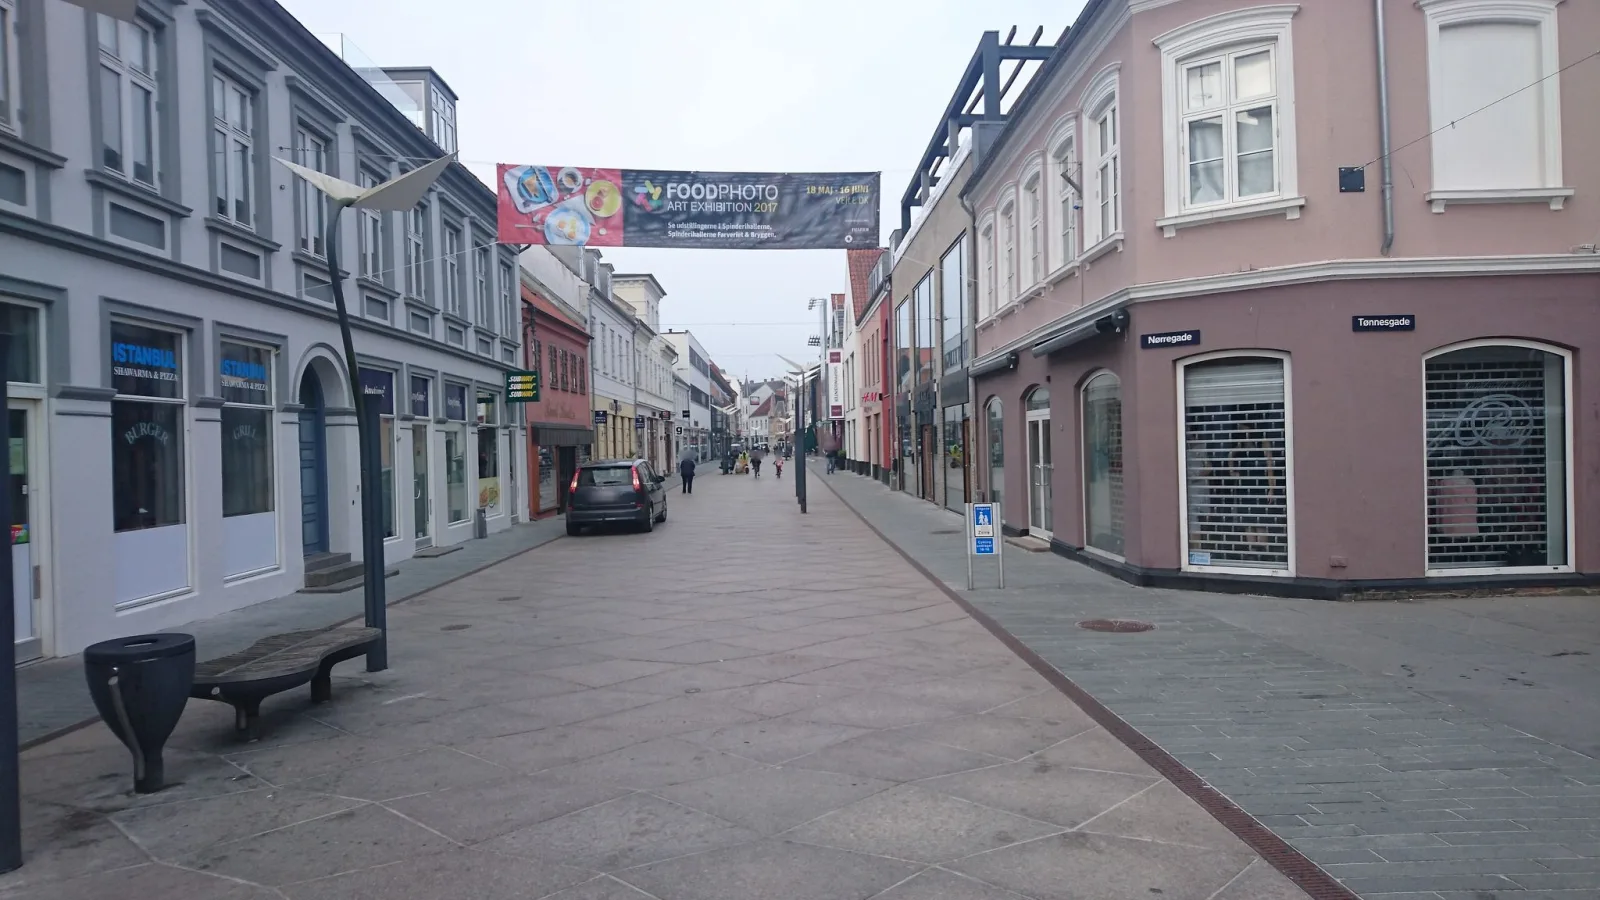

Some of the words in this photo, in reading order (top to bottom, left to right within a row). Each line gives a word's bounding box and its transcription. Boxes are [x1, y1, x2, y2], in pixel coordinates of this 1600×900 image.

[667, 182, 779, 201] FOODPHOTO
[807, 185, 816, 194] 18
[817, 185, 833, 195] MAJ
[840, 185, 850, 194] 16
[851, 185, 869, 195] JUNI
[667, 201, 689, 212] ART
[690, 201, 752, 213] EXHIBITION
[753, 202, 778, 213] 2017
[676, 222, 717, 231] udstillingerne
[667, 230, 716, 239] Spinderihallerne
[717, 231, 743, 239] Farveriet
[744, 231, 749, 239] &
[1357, 316, 1410, 329] Tønnesgade
[1147, 332, 1193, 346] Nørregade
[113, 343, 177, 369] ISTANBUL
[113, 366, 153, 379] SHAWARMA
[153, 371, 159, 379] &
[159, 371, 179, 382] PIZZA
[220, 359, 267, 381] ISTANBUL
[221, 380, 250, 389] SHAWARMA
[254, 383, 268, 391] PIZZA
[124, 422, 169, 445] BURGER
[233, 424, 258, 440] GRILL
